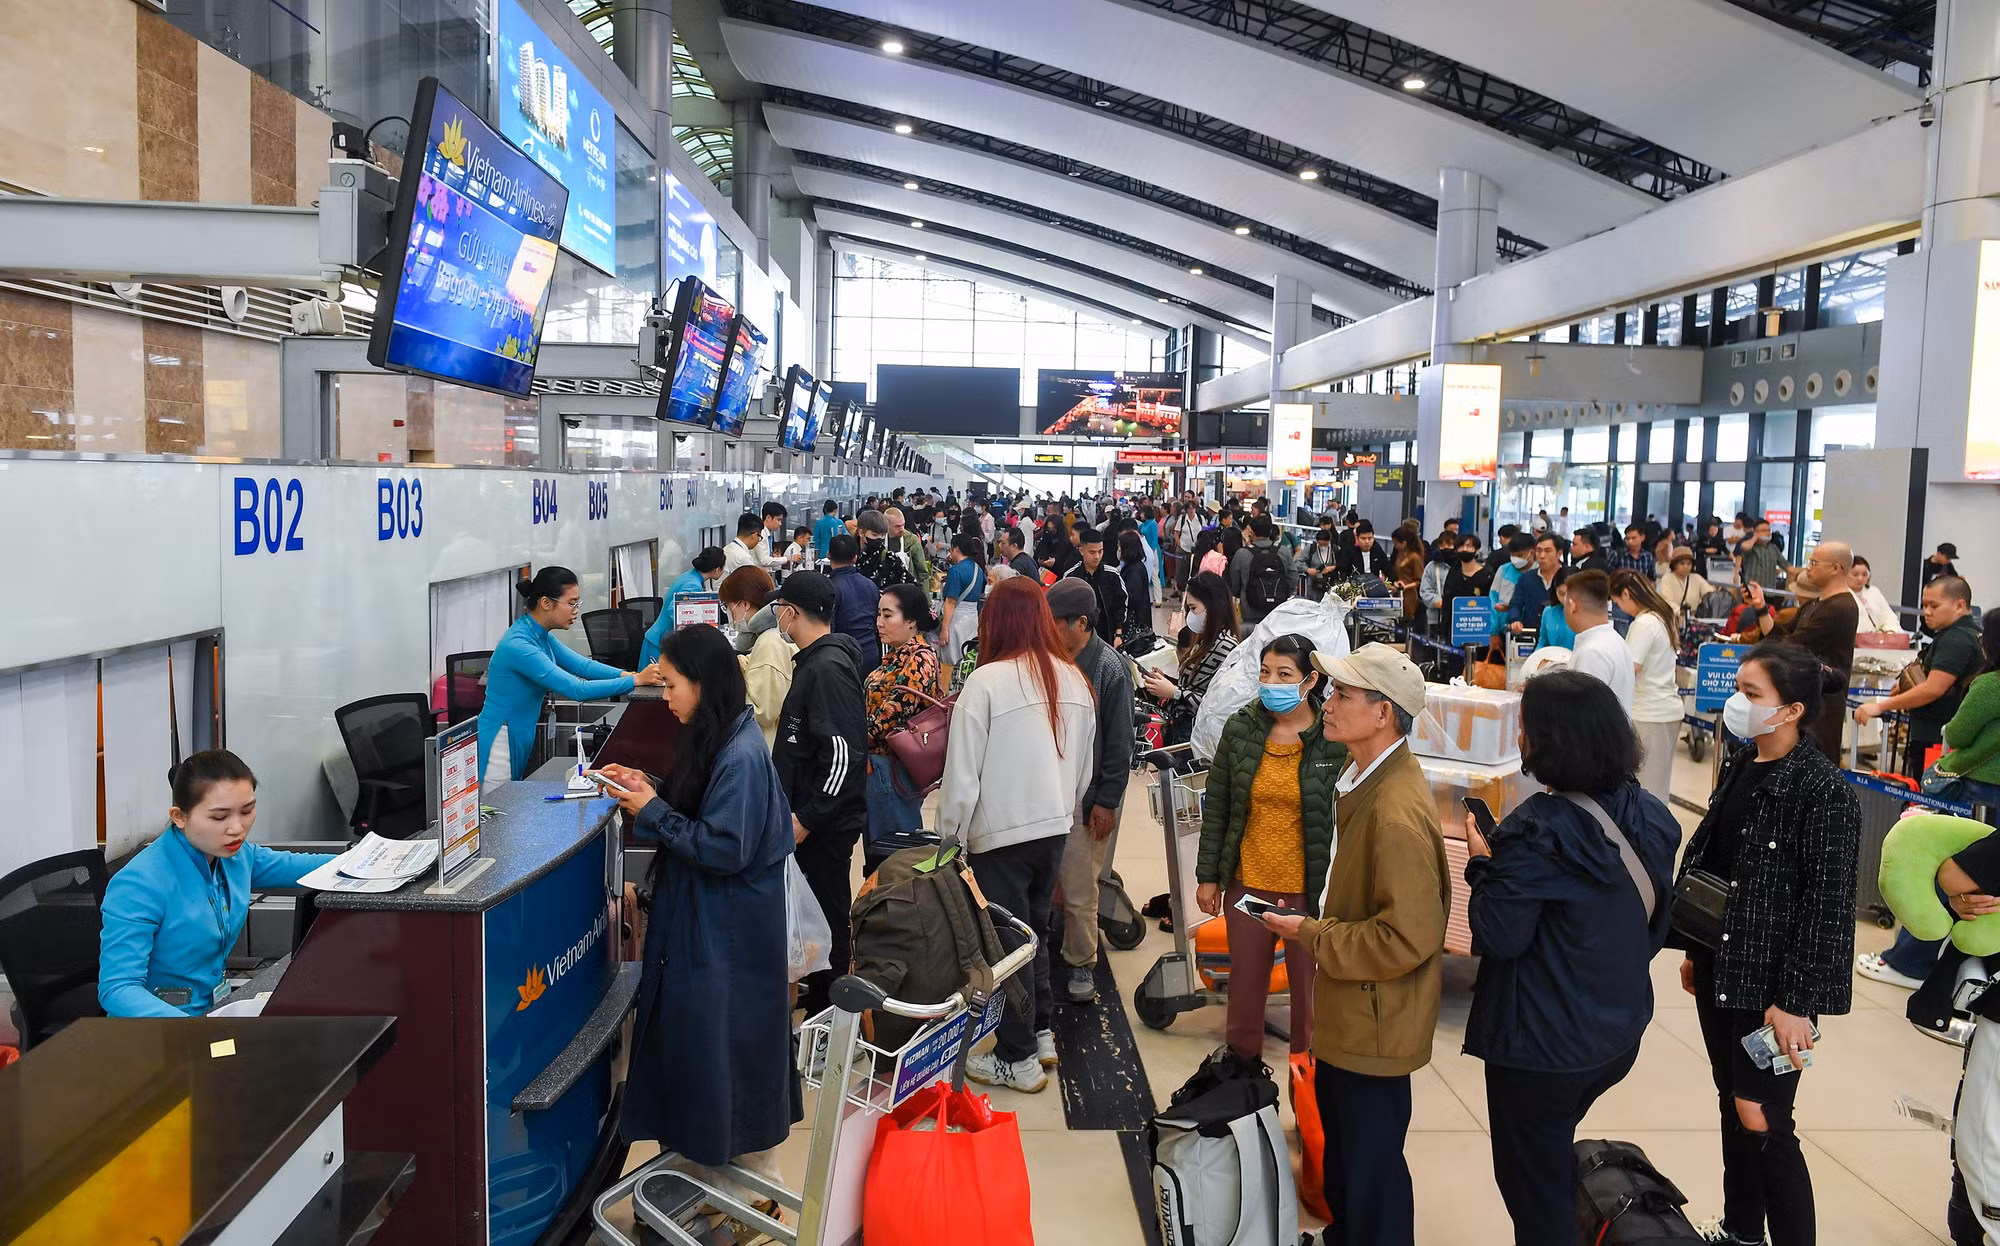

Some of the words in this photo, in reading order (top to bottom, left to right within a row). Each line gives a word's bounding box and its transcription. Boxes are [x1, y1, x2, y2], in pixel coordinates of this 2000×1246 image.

[435, 259, 484, 311] Baggage
[377, 477, 424, 541] B03
[532, 478, 558, 525] B04
[588, 480, 609, 521] B05
[660, 478, 674, 511] B06
[686, 478, 698, 508] B07
[233, 477, 304, 556] B02
[1701, 678, 1719, 687] CHỜ
[1707, 671, 1720, 679] VUI
[1884, 784, 1904, 797] NOIBAI
[1903, 791, 1949, 811] INTERNATIONAL
[937, 1022, 960, 1050] 20.000
